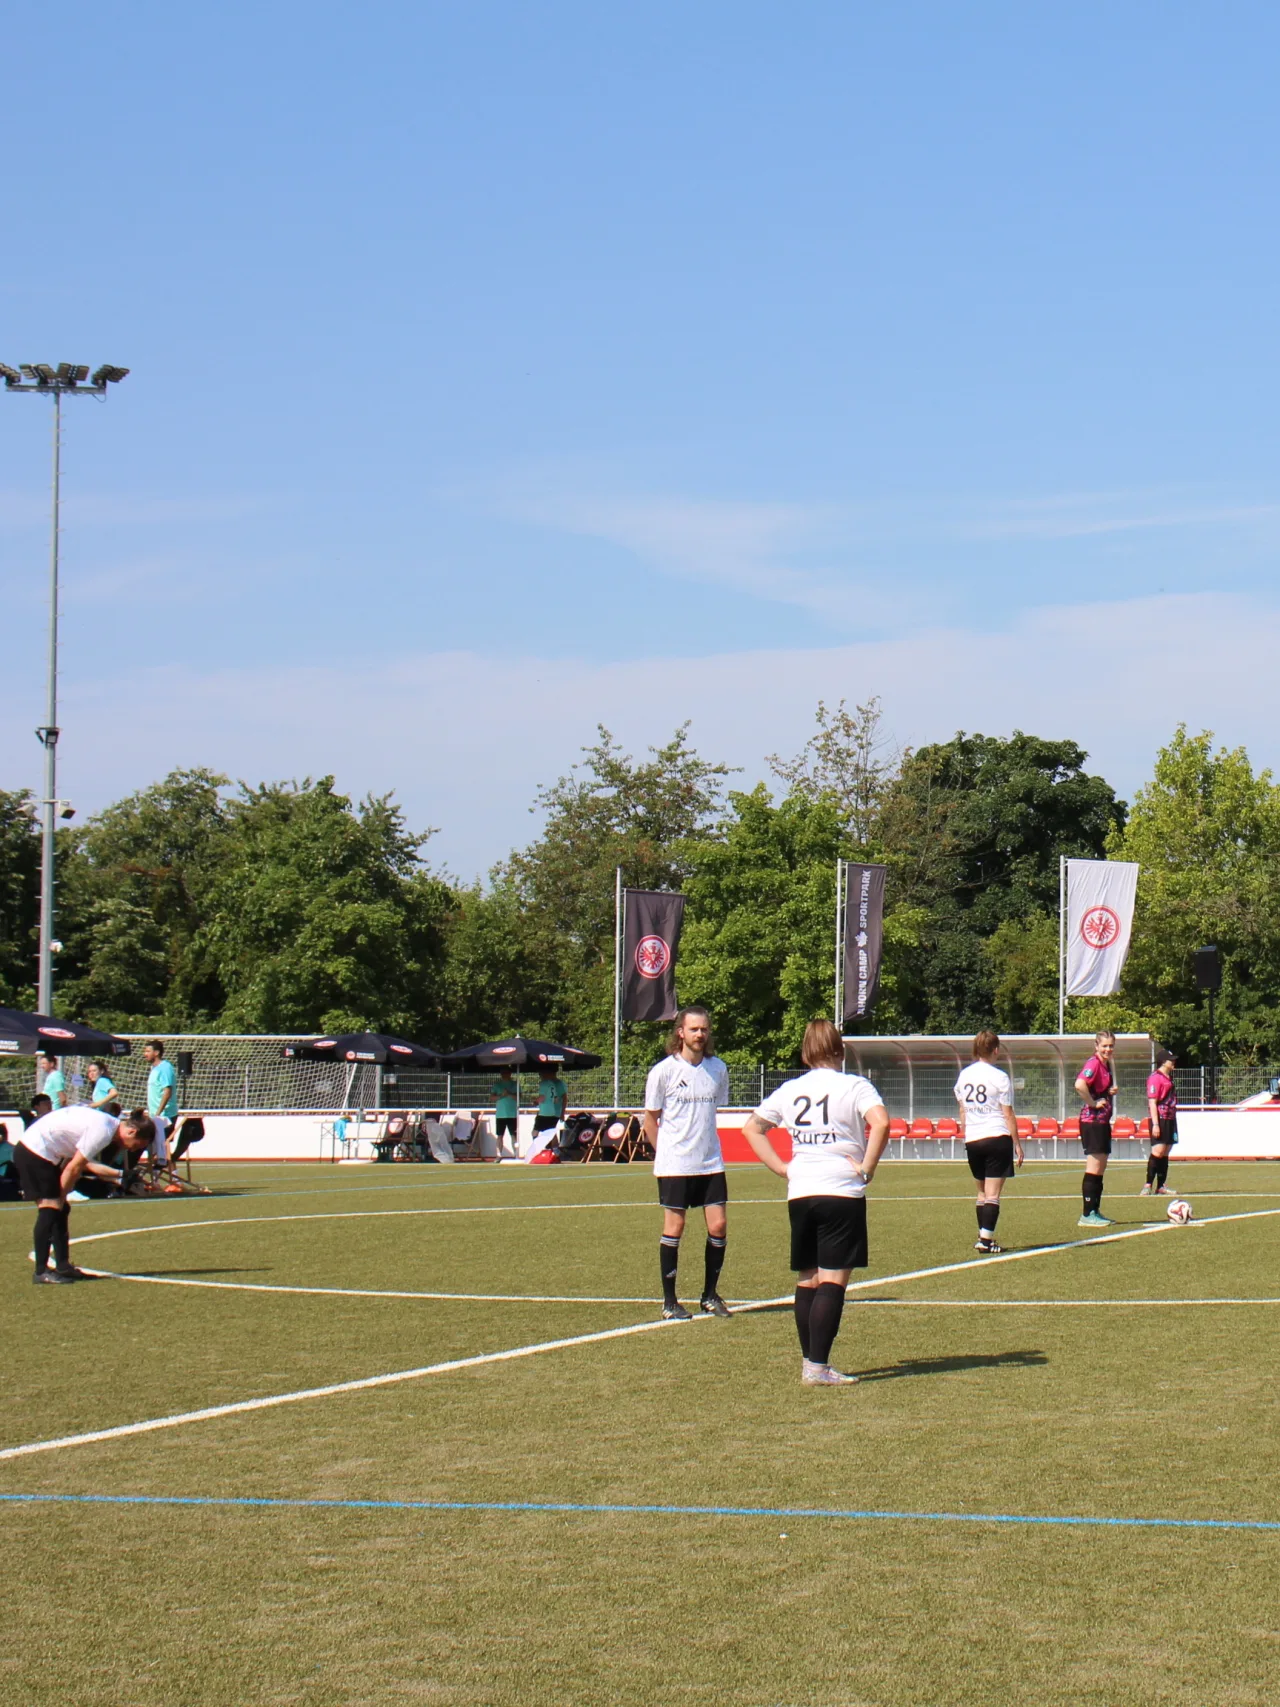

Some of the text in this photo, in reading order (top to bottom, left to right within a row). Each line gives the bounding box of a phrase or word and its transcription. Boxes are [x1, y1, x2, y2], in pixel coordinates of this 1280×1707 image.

[857, 870, 872, 1015] AHORN CAMP SPORTPARK
[964, 1083, 987, 1104] 28
[793, 1094, 829, 1126] 21
